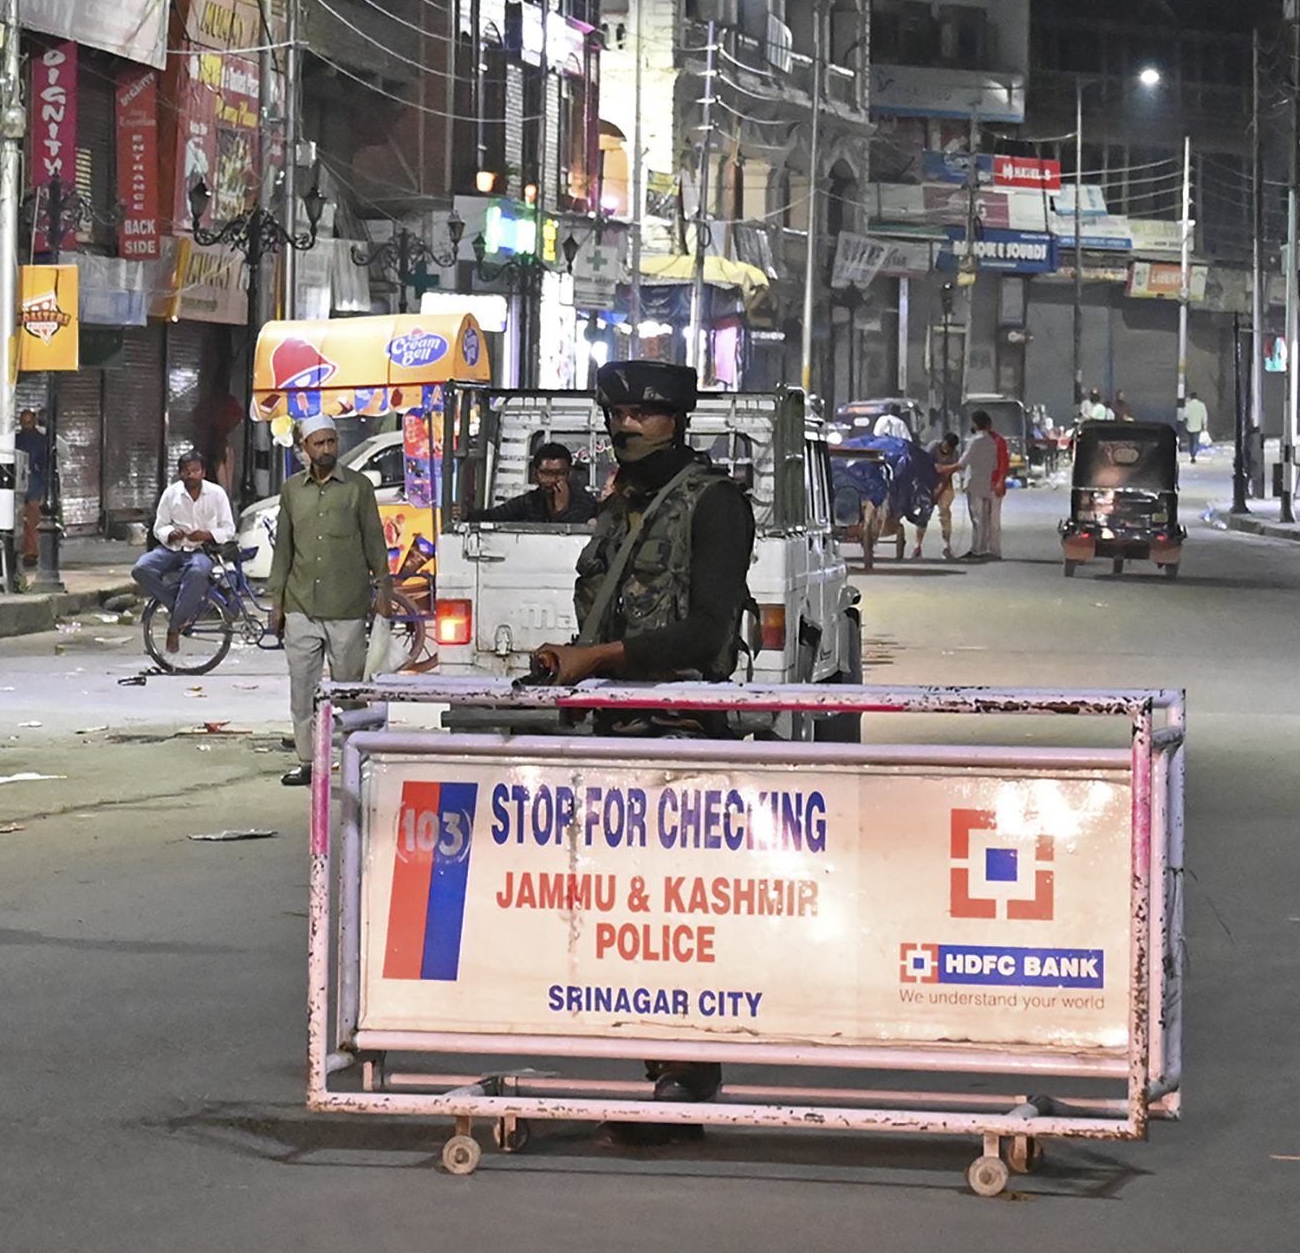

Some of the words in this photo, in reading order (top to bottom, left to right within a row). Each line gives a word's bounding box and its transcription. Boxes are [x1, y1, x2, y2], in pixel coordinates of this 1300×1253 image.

[124, 218, 156, 236] BACK
[124, 239, 157, 254] SIDE
[391, 337, 441, 354] Cream
[401, 348, 431, 366] Bell
[491, 783, 576, 845] STOP
[584, 787, 647, 848] FOR
[496, 871, 617, 912] JAMMU
[627, 876, 651, 913] &
[664, 876, 819, 917] KASHMIR
[596, 922, 716, 963] POLICE
[945, 953, 1016, 976] HDFC
[1023, 956, 1100, 978] BANK
[548, 985, 689, 1018] SRINAGAR
[698, 990, 763, 1017] CITY
[899, 988, 924, 1004] We
[929, 990, 1018, 1007] understand
[1023, 993, 1057, 1010] your
[1061, 995, 1105, 1010] world
